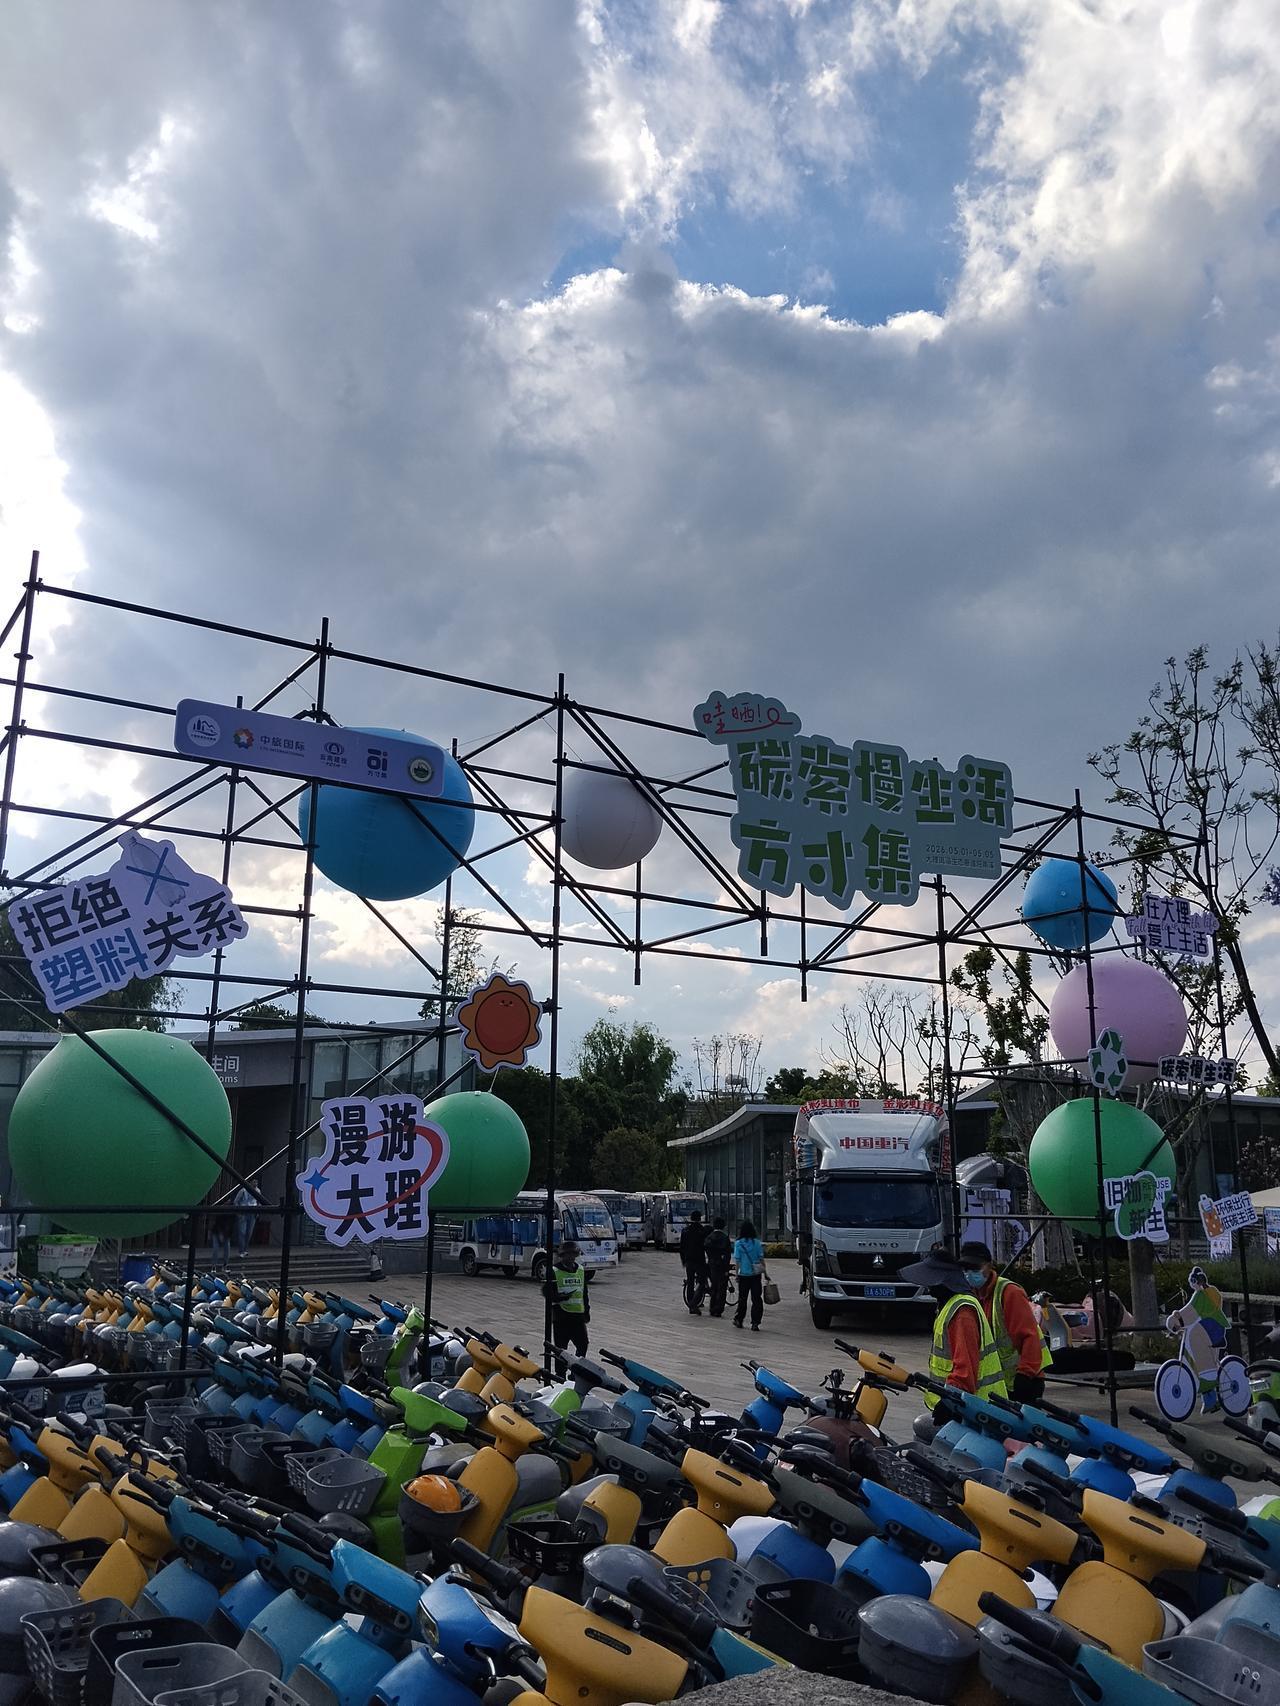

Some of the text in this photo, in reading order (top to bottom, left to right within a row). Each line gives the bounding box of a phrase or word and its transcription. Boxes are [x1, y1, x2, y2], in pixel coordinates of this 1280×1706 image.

[736, 739, 1006, 828] 碳索慢生活
[740, 818, 912, 898] 方寸集
[17, 878, 131, 953] 拒绝
[1146, 895, 1191, 925] 在大理
[1148, 922, 1207, 955] 爱上生活
[204, 1055, 239, 1072] 生间
[1161, 1058, 1234, 1082] 碳索慢生活
[329, 1102, 417, 1167] 漫游
[839, 1136, 909, 1151] 中国重汽
[334, 1168, 422, 1238] 大理
[1107, 1178, 1142, 1206] 旧物
[1215, 1193, 1251, 1216] 环保出行
[1129, 1206, 1164, 1234] 新生
[1221, 1207, 1256, 1230] 低碳生活
